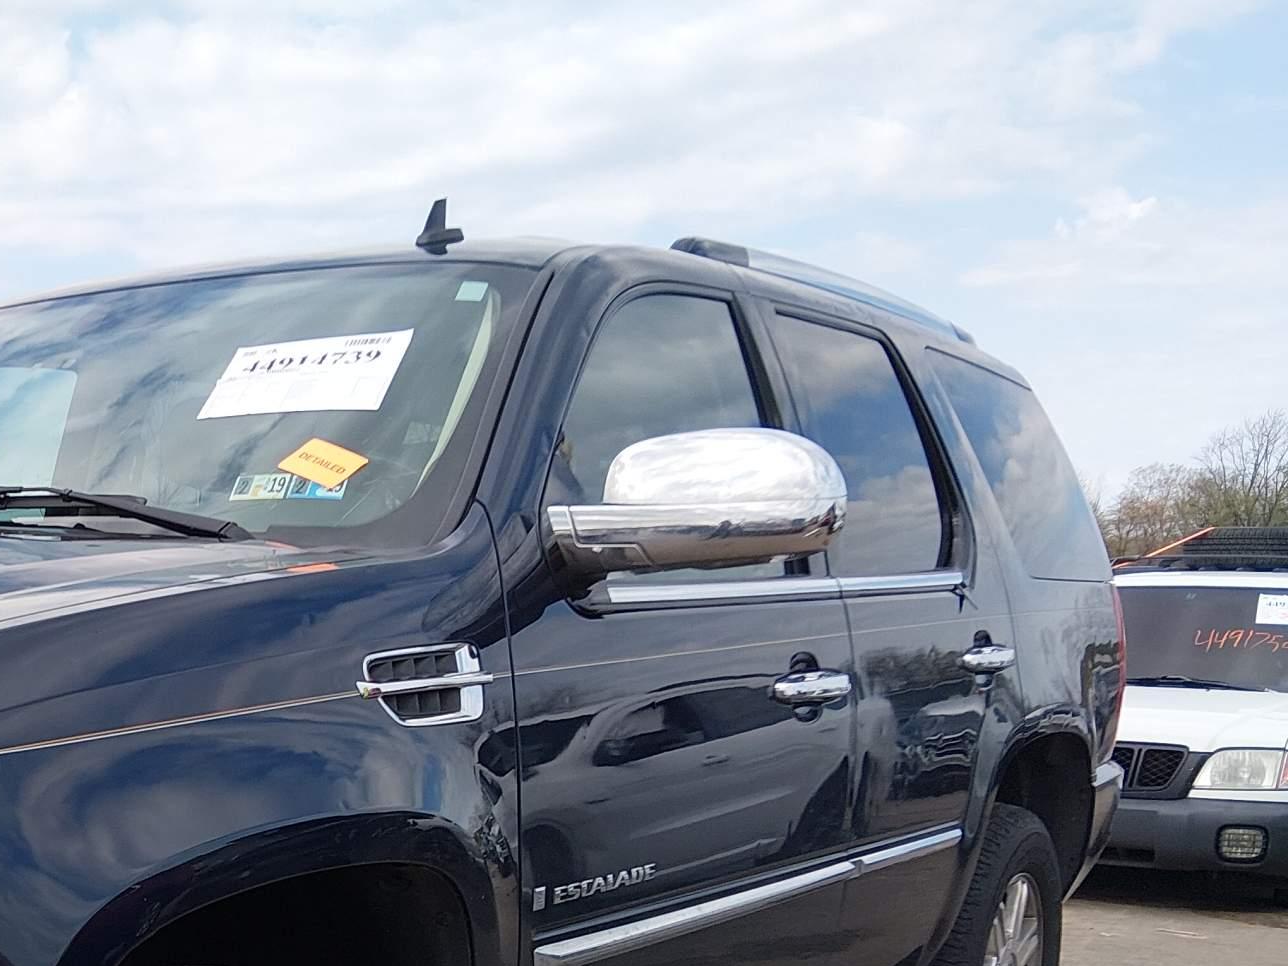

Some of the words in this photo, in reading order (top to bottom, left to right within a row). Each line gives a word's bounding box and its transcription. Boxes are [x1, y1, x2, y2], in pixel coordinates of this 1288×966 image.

[242, 350, 382, 373] 44914739
[298, 451, 347, 475] DETAILED
[268, 476, 287, 493] 19
[553, 863, 657, 905] ESCALADE
